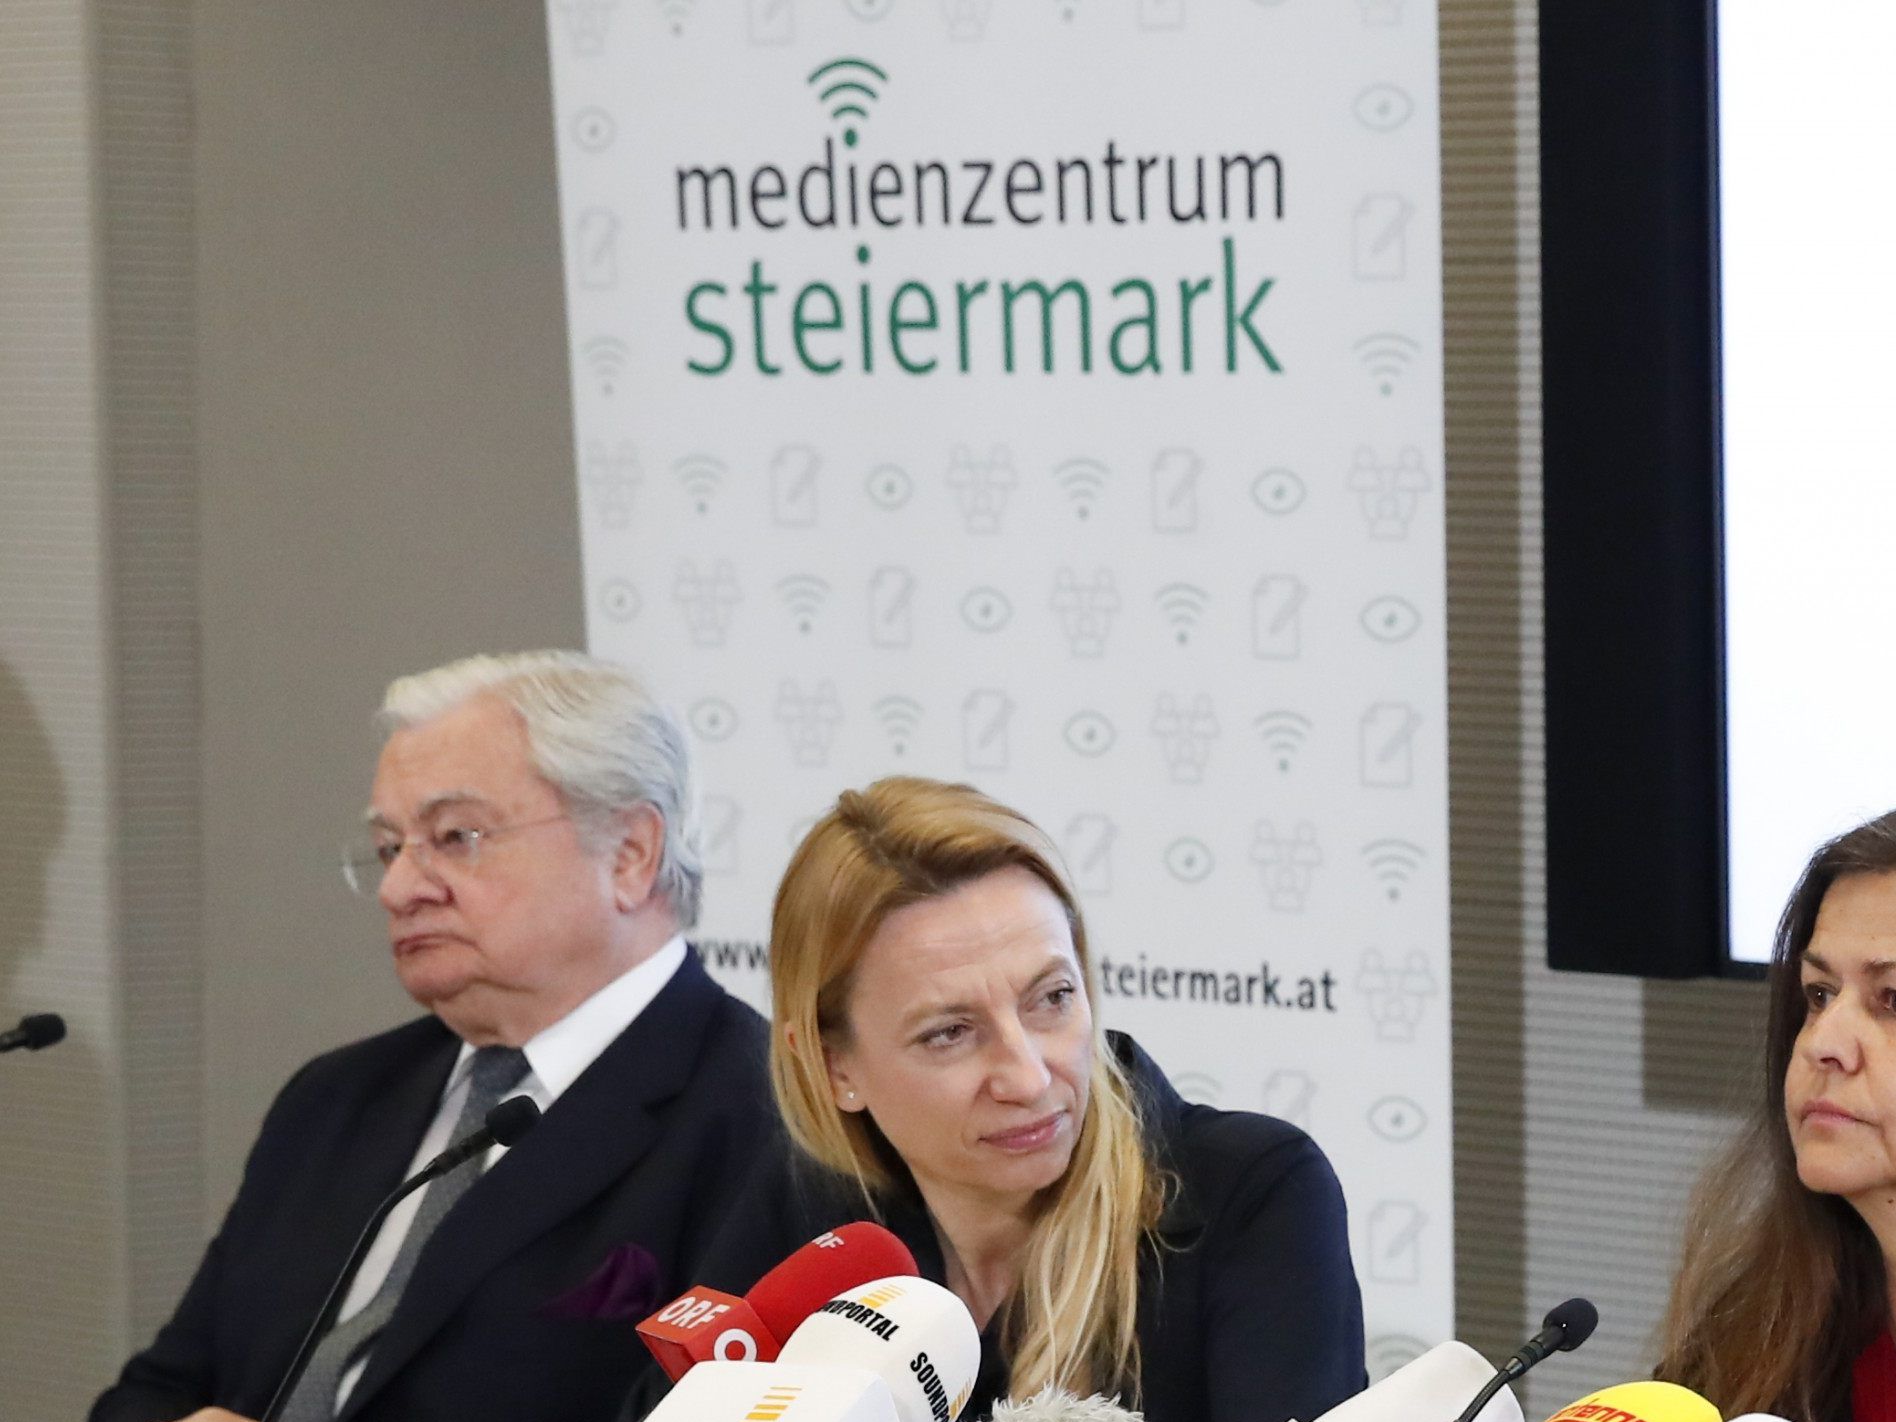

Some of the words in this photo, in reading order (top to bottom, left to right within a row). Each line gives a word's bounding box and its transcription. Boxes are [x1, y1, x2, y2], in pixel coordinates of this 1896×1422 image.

[675, 133, 1285, 230] medienzentrum
[684, 238, 1284, 376] steiermark
[1101, 956, 1337, 1012] teiermark.at
[811, 1231, 845, 1249] RF
[657, 1296, 731, 1330] ORF
